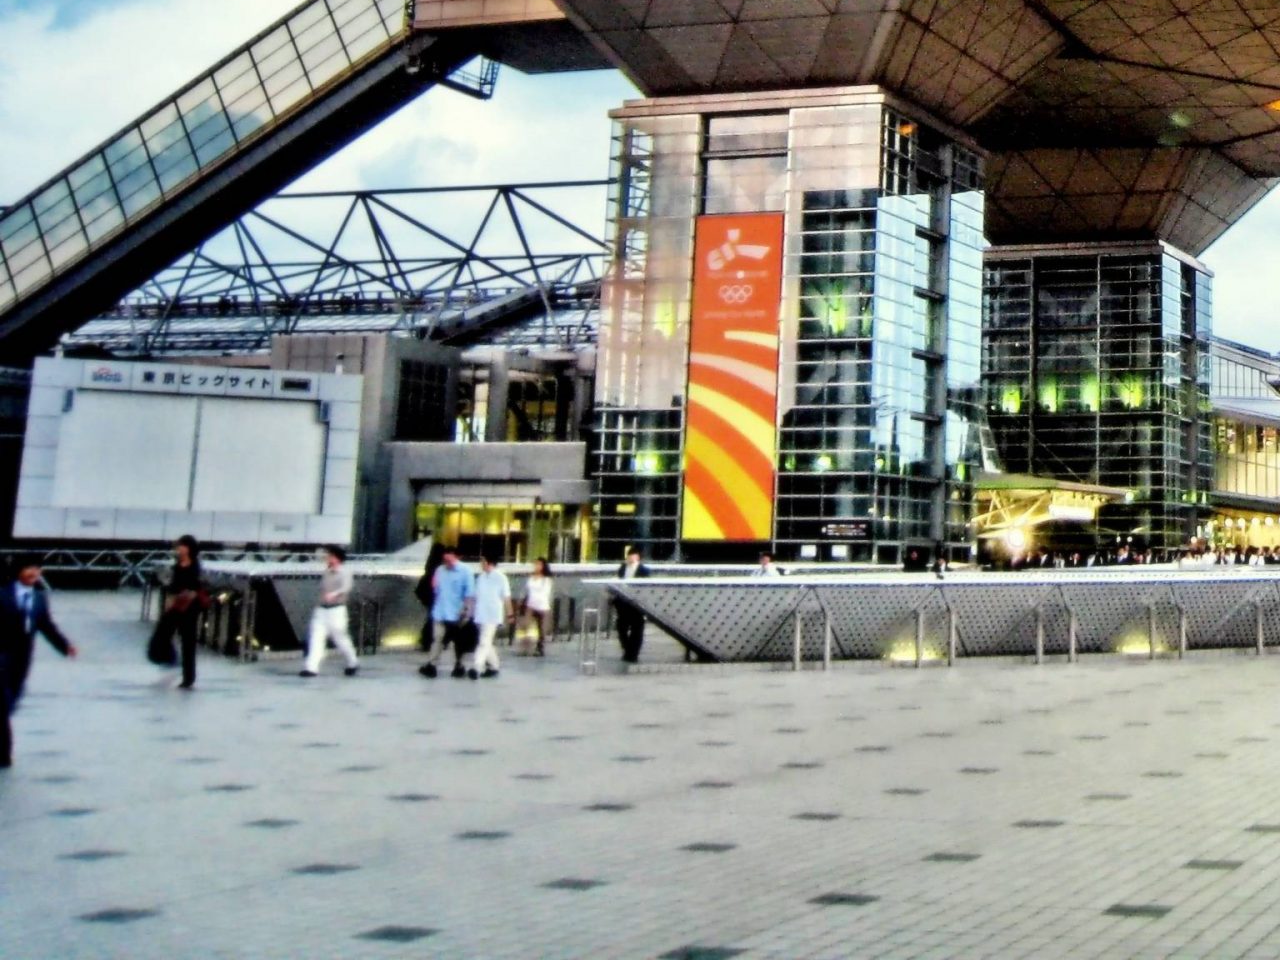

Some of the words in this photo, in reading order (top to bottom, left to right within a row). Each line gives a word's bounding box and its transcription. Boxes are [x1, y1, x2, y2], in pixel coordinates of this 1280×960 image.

[143, 371, 271, 389] 東京ビッグサイト
